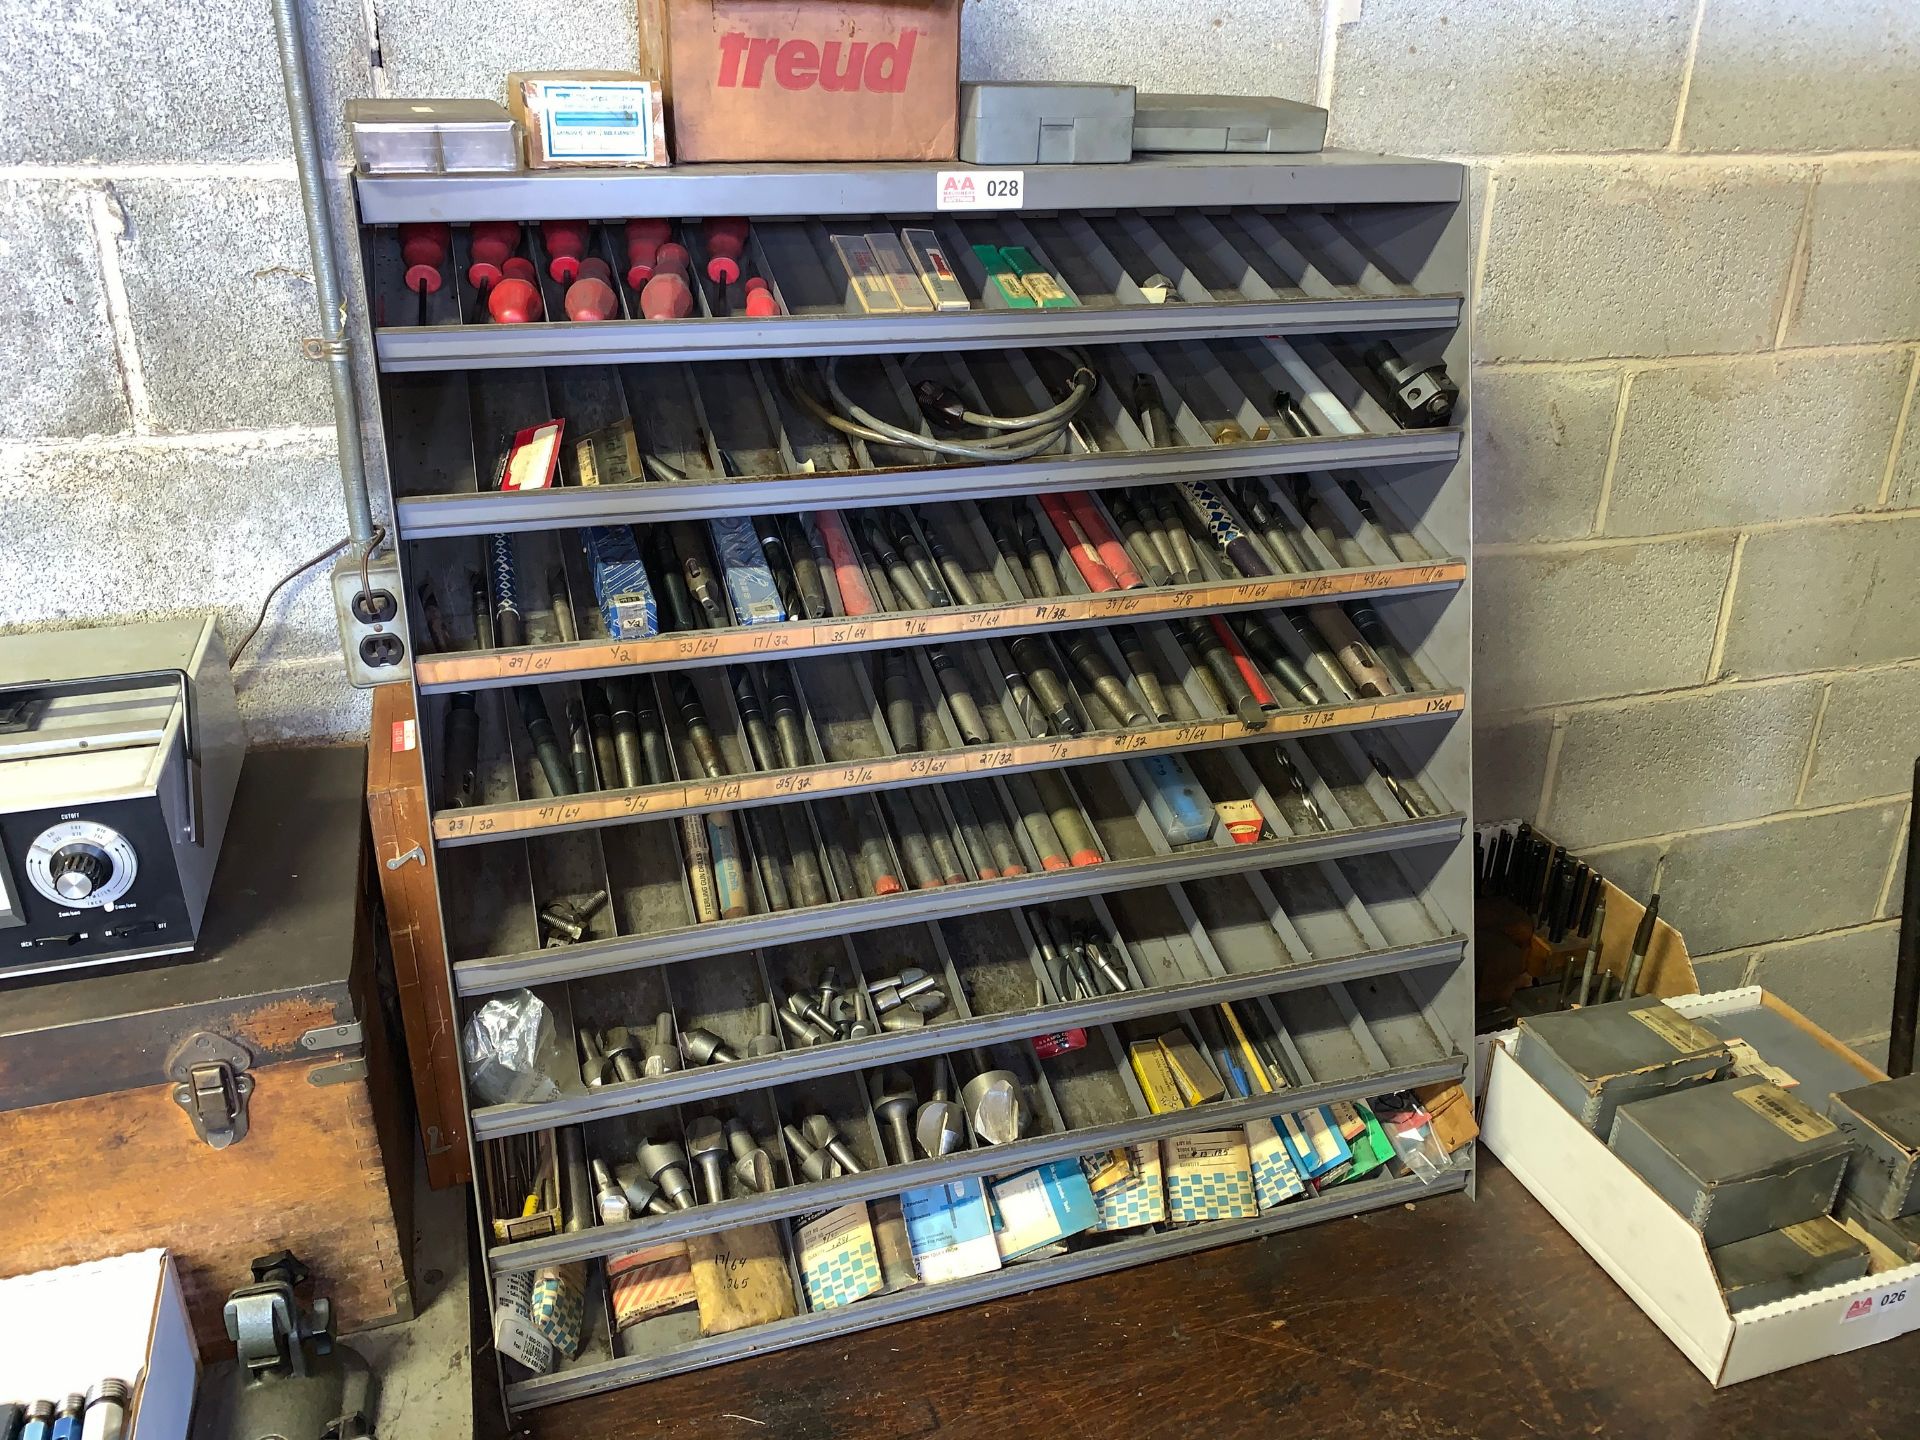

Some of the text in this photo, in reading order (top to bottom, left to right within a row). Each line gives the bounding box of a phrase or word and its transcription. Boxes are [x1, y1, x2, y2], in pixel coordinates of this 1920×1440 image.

[987, 180, 1019, 197] 028
[1363, 571, 1392, 588] 43/64
[1173, 591, 1194, 606] 5/8
[1238, 584, 1269, 599] 41/64
[1105, 596, 1140, 611] 39/64
[905, 619, 926, 635] 9/16
[969, 612, 1000, 627] 37/64
[753, 632, 789, 649] 17/32
[831, 625, 866, 642] 35/64
[610, 645, 631, 662] 1/2
[680, 638, 719, 655] 33/64
[509, 652, 552, 672] 29/64
[1302, 710, 1335, 728] 31/32
[1114, 734, 1147, 750] 29/32
[1175, 726, 1207, 742] 59/64
[1049, 743, 1068, 759] 7/8
[910, 757, 947, 774] 53/64
[775, 775, 811, 792] 25/32
[843, 767, 872, 784] 13/16
[704, 782, 741, 801] 49/64
[623, 795, 649, 812] 3/4
[60, 812, 80, 820] CUTOFF
[538, 804, 581, 823] 47/64
[449, 815, 495, 834] 23/32
[701, 886, 712, 915] STERLING
[715, 1250, 747, 1272] 17/64
[723, 1276, 750, 1290] .265
[1881, 1290, 1907, 1307] 026
